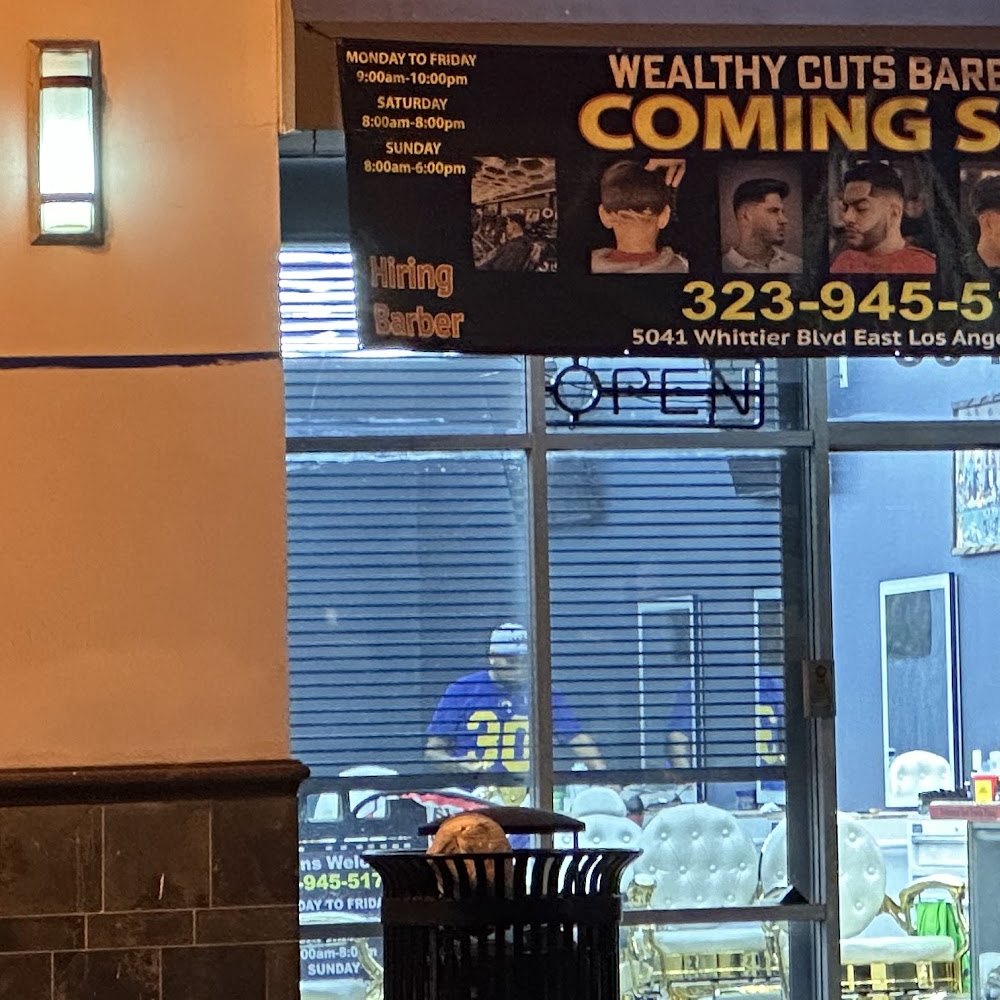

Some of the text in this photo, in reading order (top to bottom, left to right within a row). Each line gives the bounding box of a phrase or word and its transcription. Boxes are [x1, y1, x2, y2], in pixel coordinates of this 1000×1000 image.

[346, 51, 477, 67] MONDAY TO FRIDAY
[356, 70, 468, 88] 9:00am-10:00pm
[608, 54, 787, 90] WEALTHY
[797, 55, 895, 90] CUTS
[377, 96, 448, 110] SATURDAY
[362, 115, 465, 132] 8:00am-8:00pm
[578, 93, 932, 151] COMING
[385, 141, 441, 155] SUNDAY
[364, 159, 466, 177] 8:00am-6:00pm
[370, 256, 453, 298] Hiring
[374, 302, 465, 338] Barber
[632, 328, 688, 346] 5041
[694, 328, 790, 347] Whittier
[797, 328, 846, 347] Blvd
[854, 329, 902, 346] East
[908, 329, 946, 347] Los
[553, 364, 750, 416] OPEN
[326, 854, 370, 870] Welc
[299, 872, 382, 891] -945-517
[299, 899, 322, 911] DAY
[324, 898, 344, 911] TO
[308, 961, 360, 976] SUNDAY
